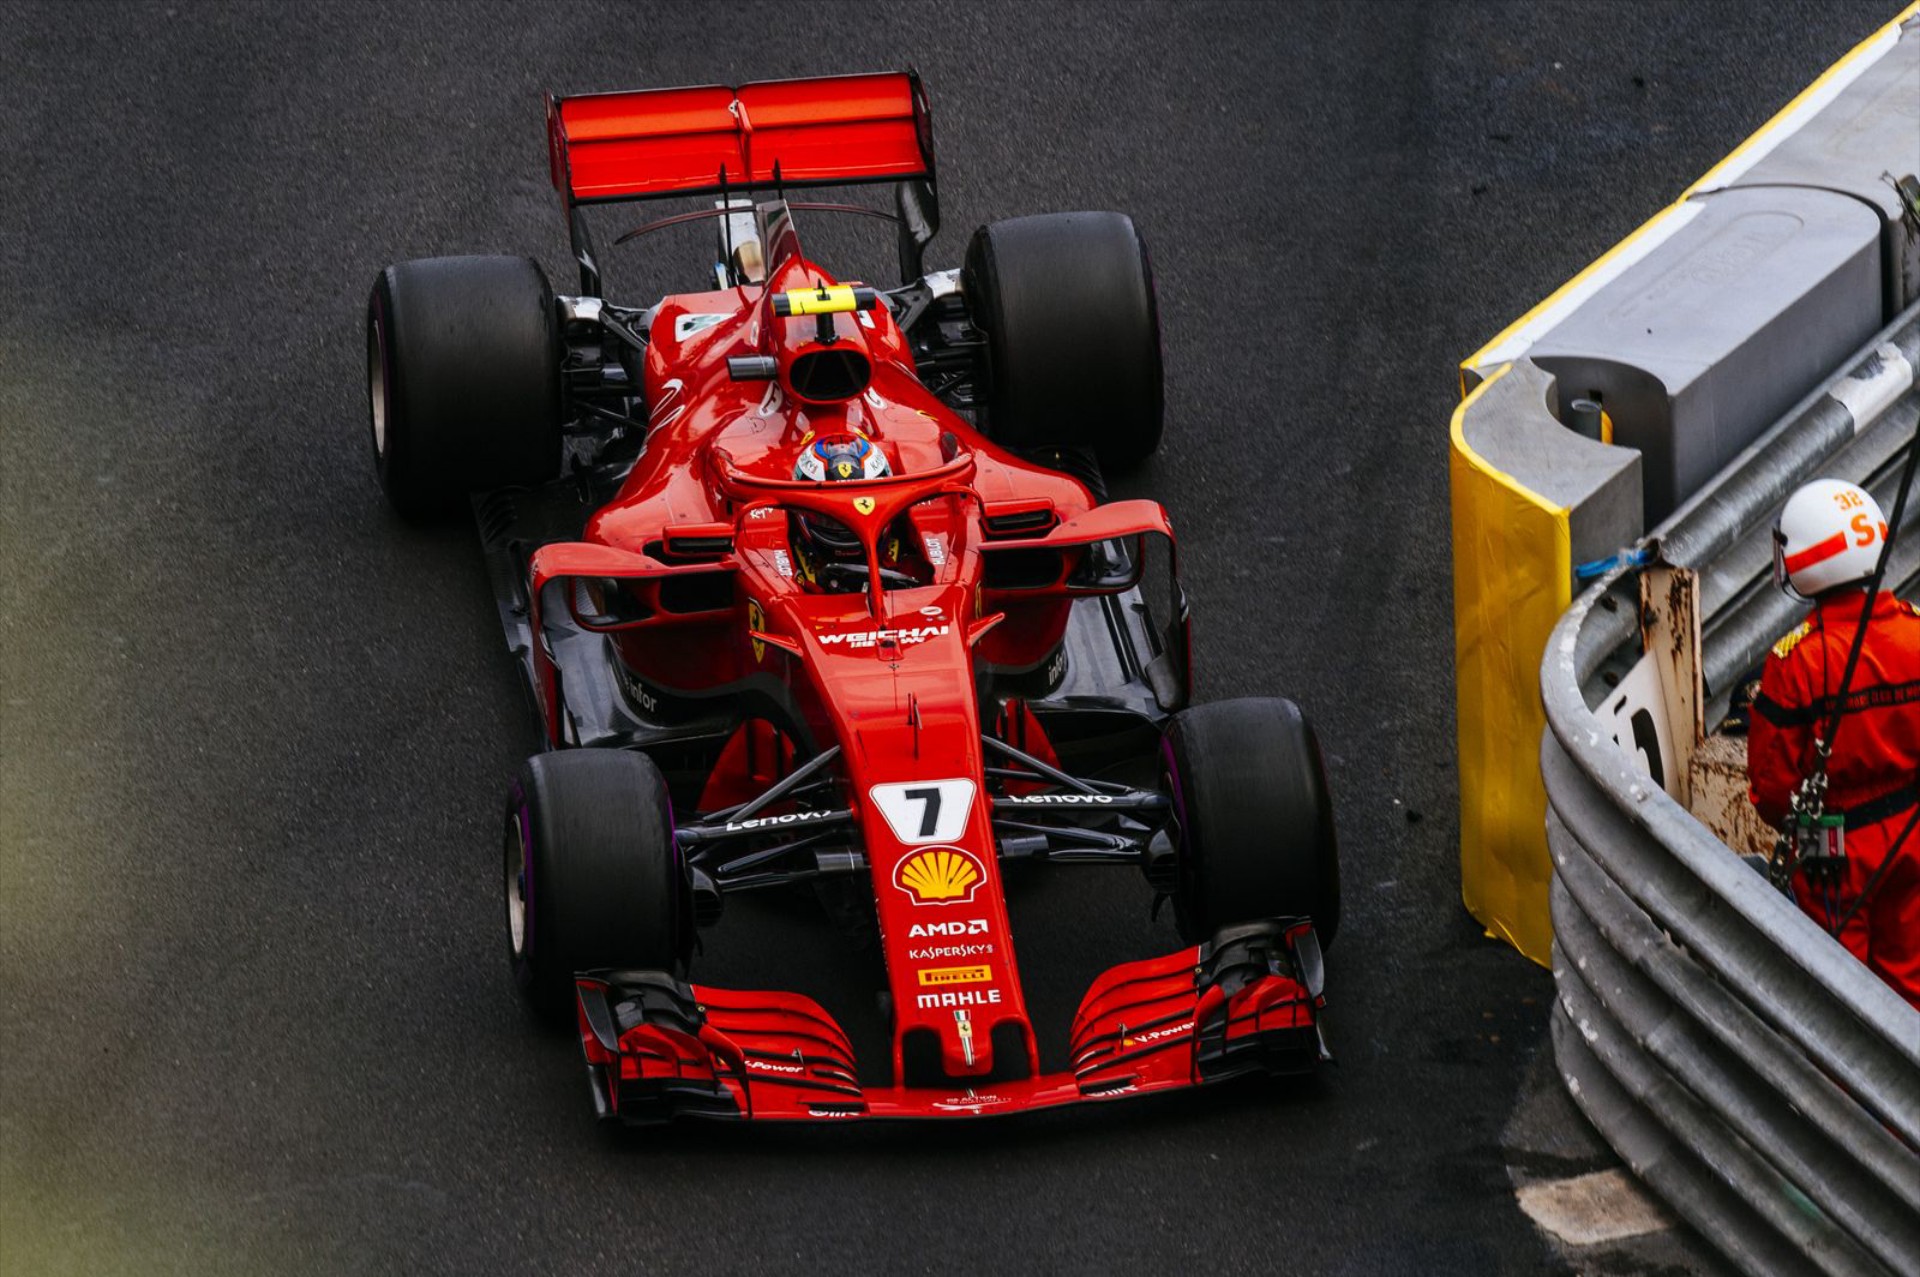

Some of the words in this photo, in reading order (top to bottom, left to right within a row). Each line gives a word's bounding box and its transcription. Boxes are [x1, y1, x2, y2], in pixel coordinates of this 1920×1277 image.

[818, 625, 949, 645] WEICHAI
[1008, 794, 1113, 804] Lenovo
[726, 810, 831, 832] Lenovo
[904, 787, 942, 837] 7
[908, 922, 966, 938] AMD
[909, 943, 984, 960] KASPERSKY
[924, 968, 984, 982] PIRELLI
[916, 989, 1001, 1009] MAHLE
